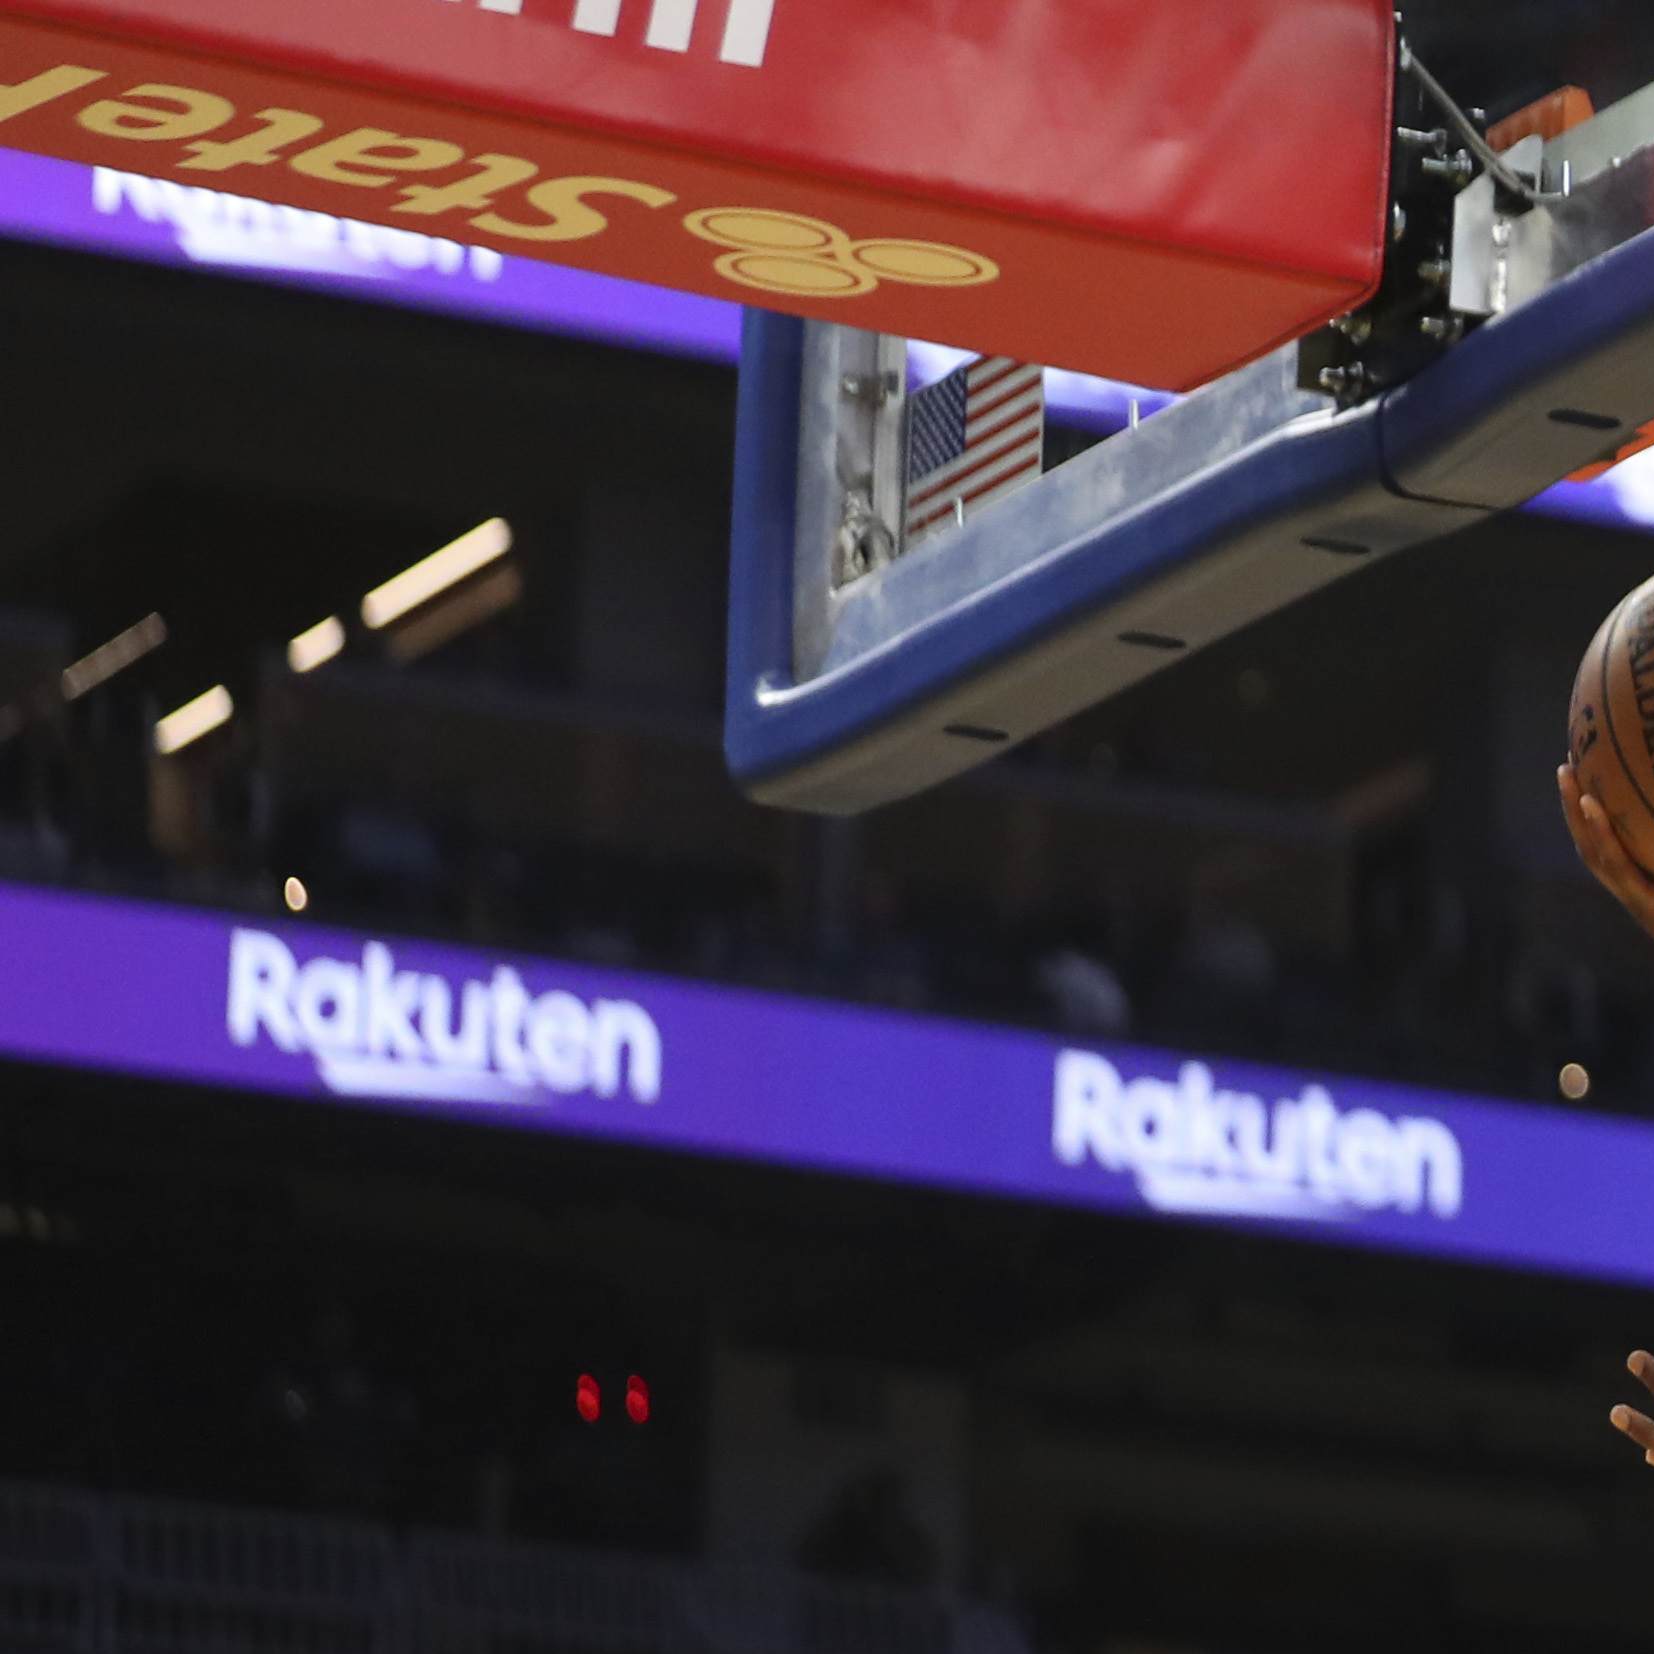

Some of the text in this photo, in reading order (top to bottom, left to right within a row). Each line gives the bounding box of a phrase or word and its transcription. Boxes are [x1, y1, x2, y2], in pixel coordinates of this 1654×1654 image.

[75, 83, 678, 241] State
[228, 928, 660, 1105] Rakuten
[1053, 1047, 1462, 1220] Rakuten
